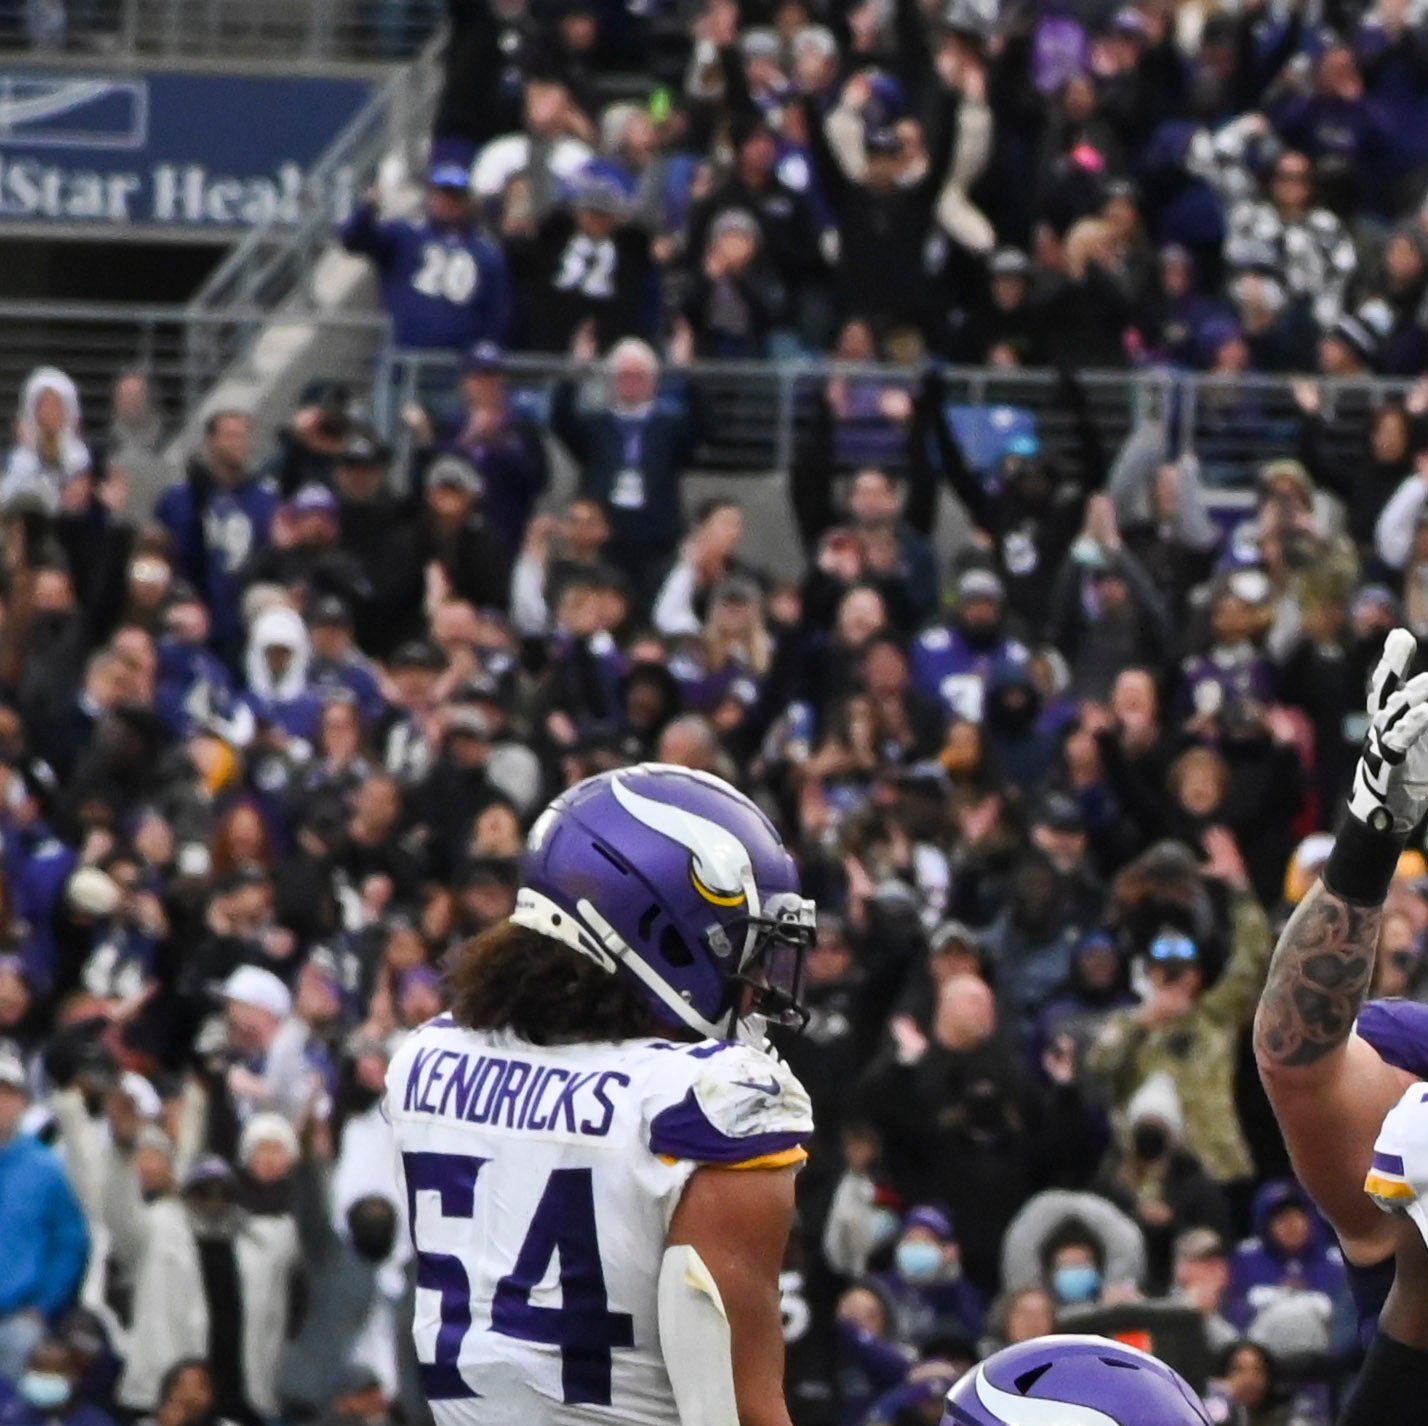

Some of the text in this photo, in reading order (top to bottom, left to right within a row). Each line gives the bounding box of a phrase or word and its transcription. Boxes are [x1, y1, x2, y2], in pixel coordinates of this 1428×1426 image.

[0, 158, 362, 226] Star Heal
[403, 1046, 631, 1138] KENDRICKS
[400, 1150, 636, 1407] 54
